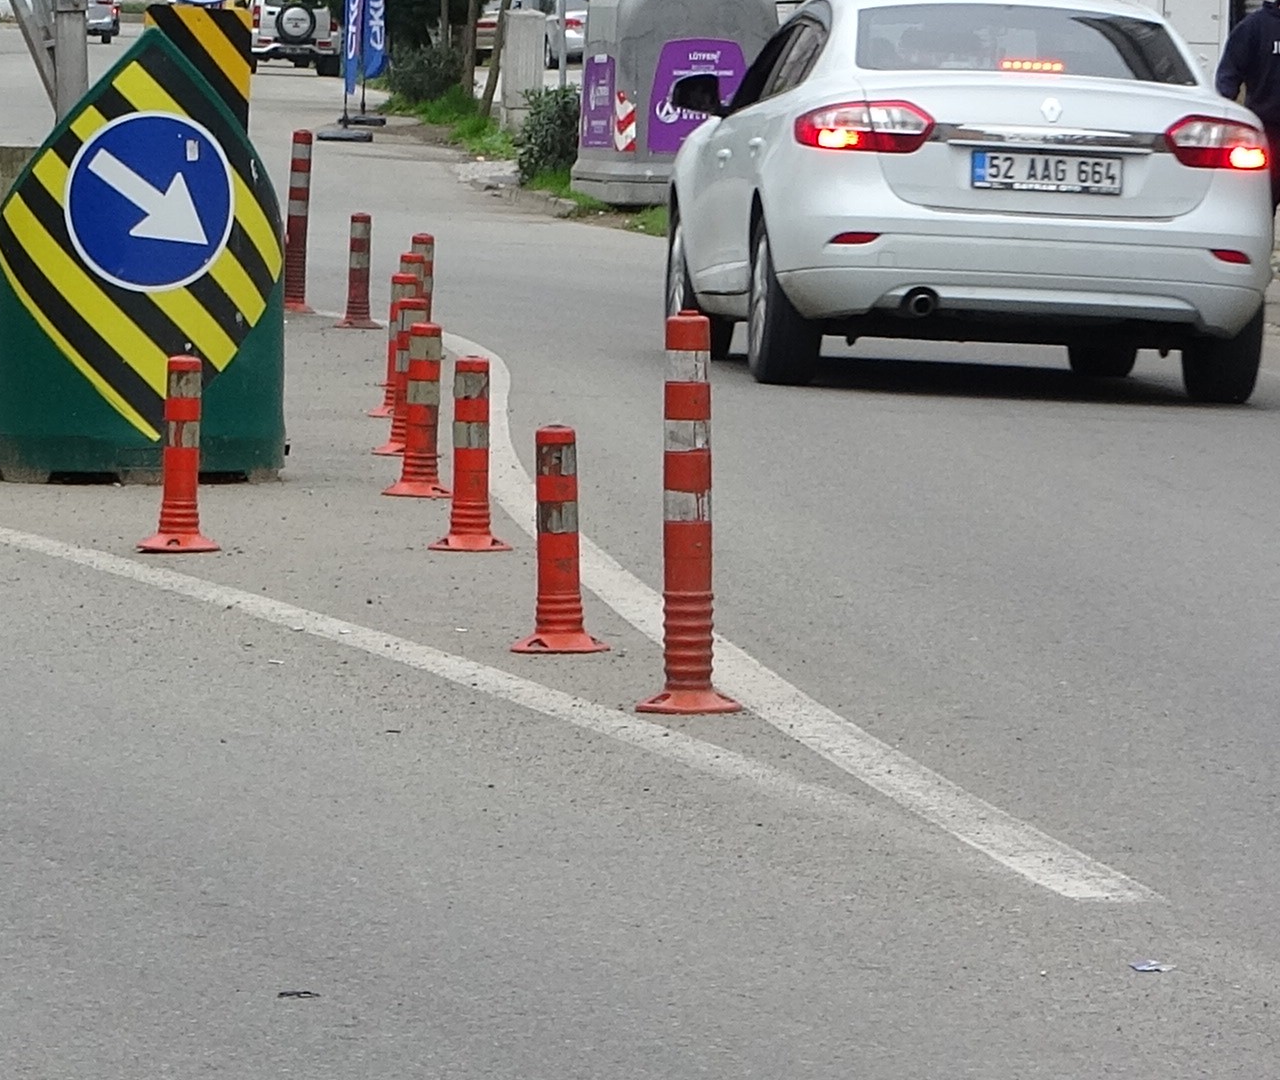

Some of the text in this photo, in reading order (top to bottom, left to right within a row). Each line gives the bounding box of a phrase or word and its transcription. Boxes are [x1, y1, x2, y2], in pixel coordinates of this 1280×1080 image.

[988, 155, 1117, 186] 52 AAG 664
